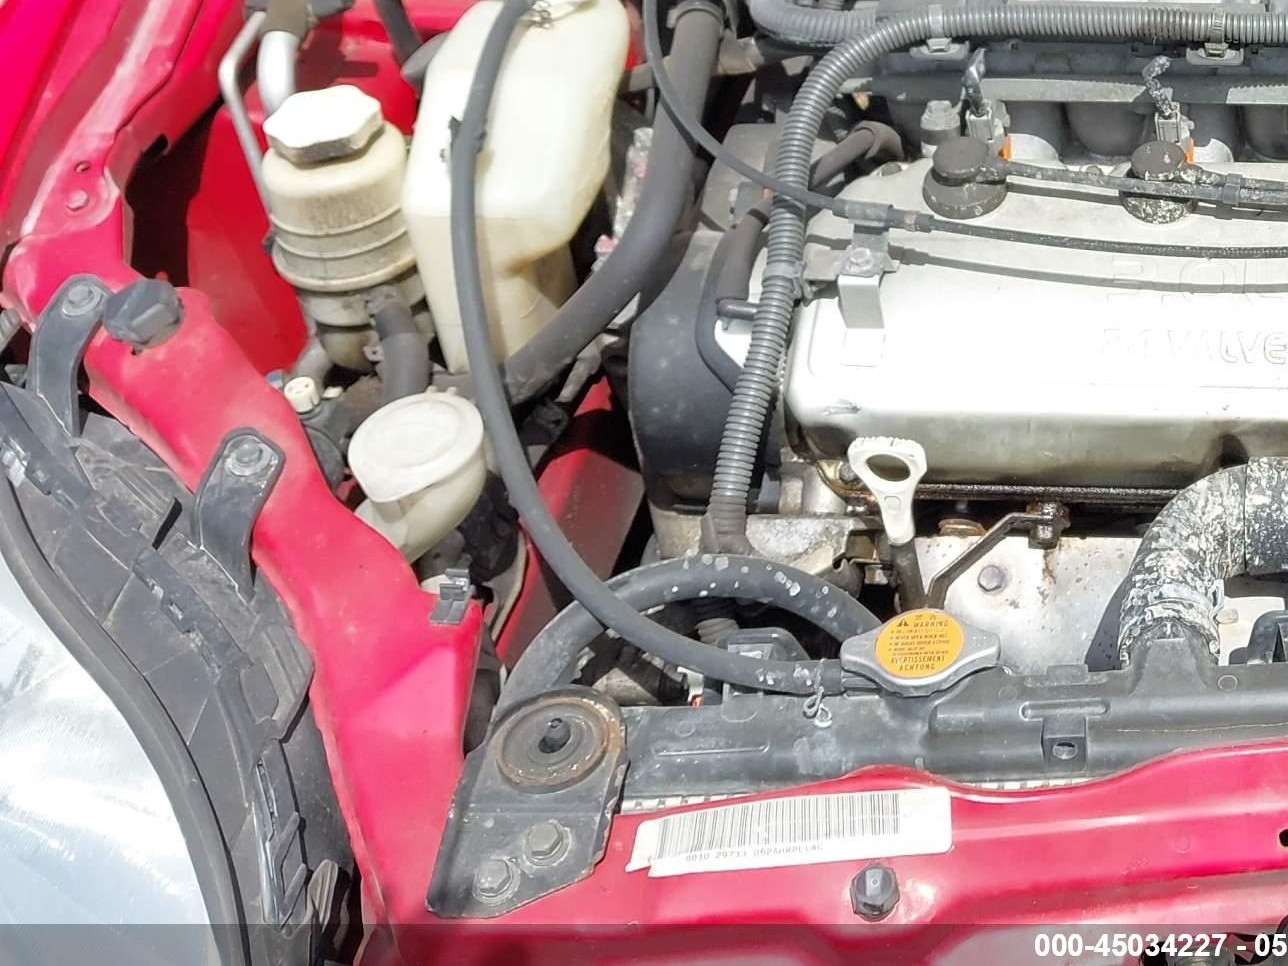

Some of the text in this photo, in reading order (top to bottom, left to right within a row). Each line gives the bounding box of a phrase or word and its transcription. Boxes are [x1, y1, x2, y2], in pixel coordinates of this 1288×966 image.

[913, 620, 948, 628] WARNING
[891, 656, 945, 664] AVERTISSEMENT
[899, 663, 935, 671] ACHTUNG
